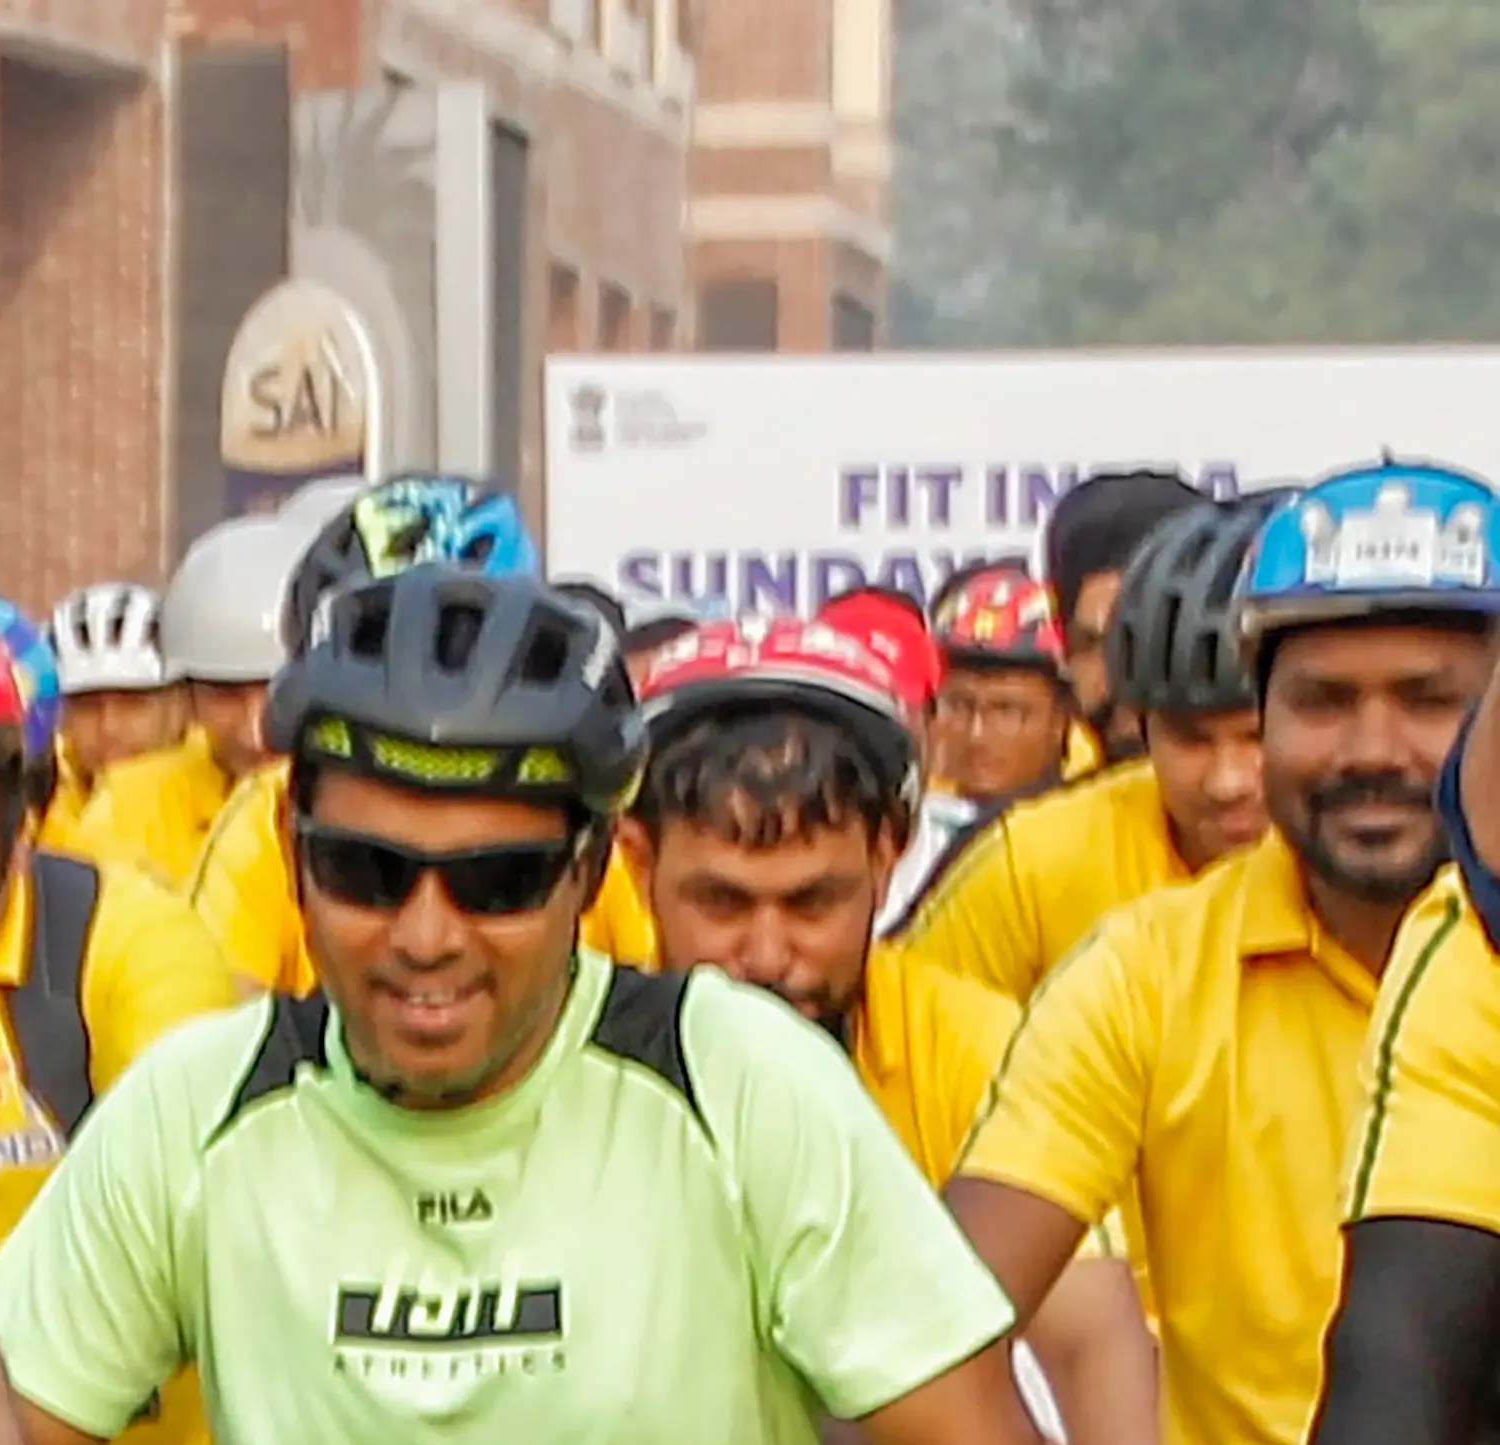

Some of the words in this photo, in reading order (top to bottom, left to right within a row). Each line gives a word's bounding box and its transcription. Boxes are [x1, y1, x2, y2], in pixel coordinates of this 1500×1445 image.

[250, 366, 339, 440] SAI
[838, 462, 963, 529] FIT
[417, 1190, 494, 1224] FILA
